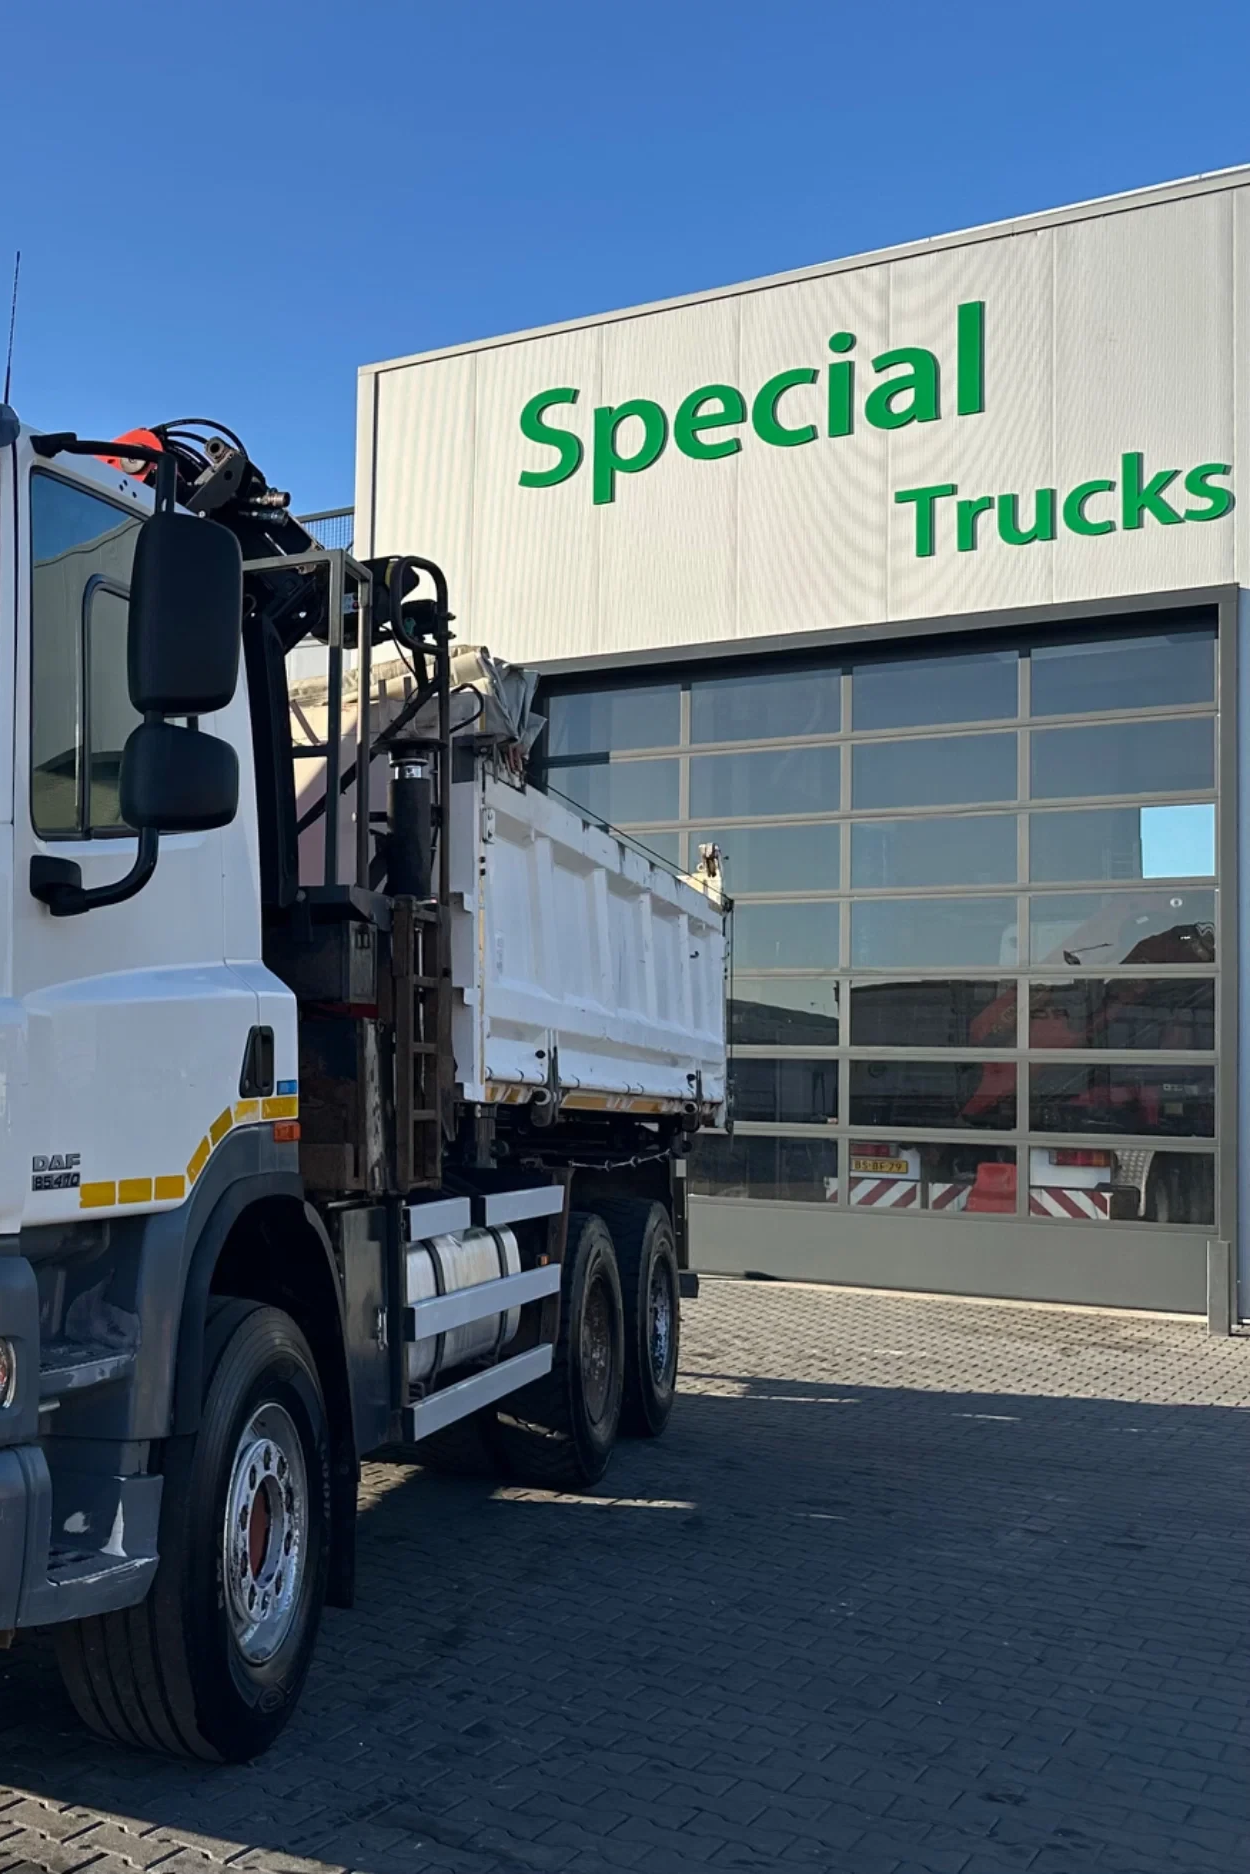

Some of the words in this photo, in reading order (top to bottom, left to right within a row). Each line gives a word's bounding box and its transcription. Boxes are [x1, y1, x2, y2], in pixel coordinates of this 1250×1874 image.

[519, 301, 986, 505] Special
[895, 452, 1235, 557] Trucks
[32, 1153, 81, 1172] DAF
